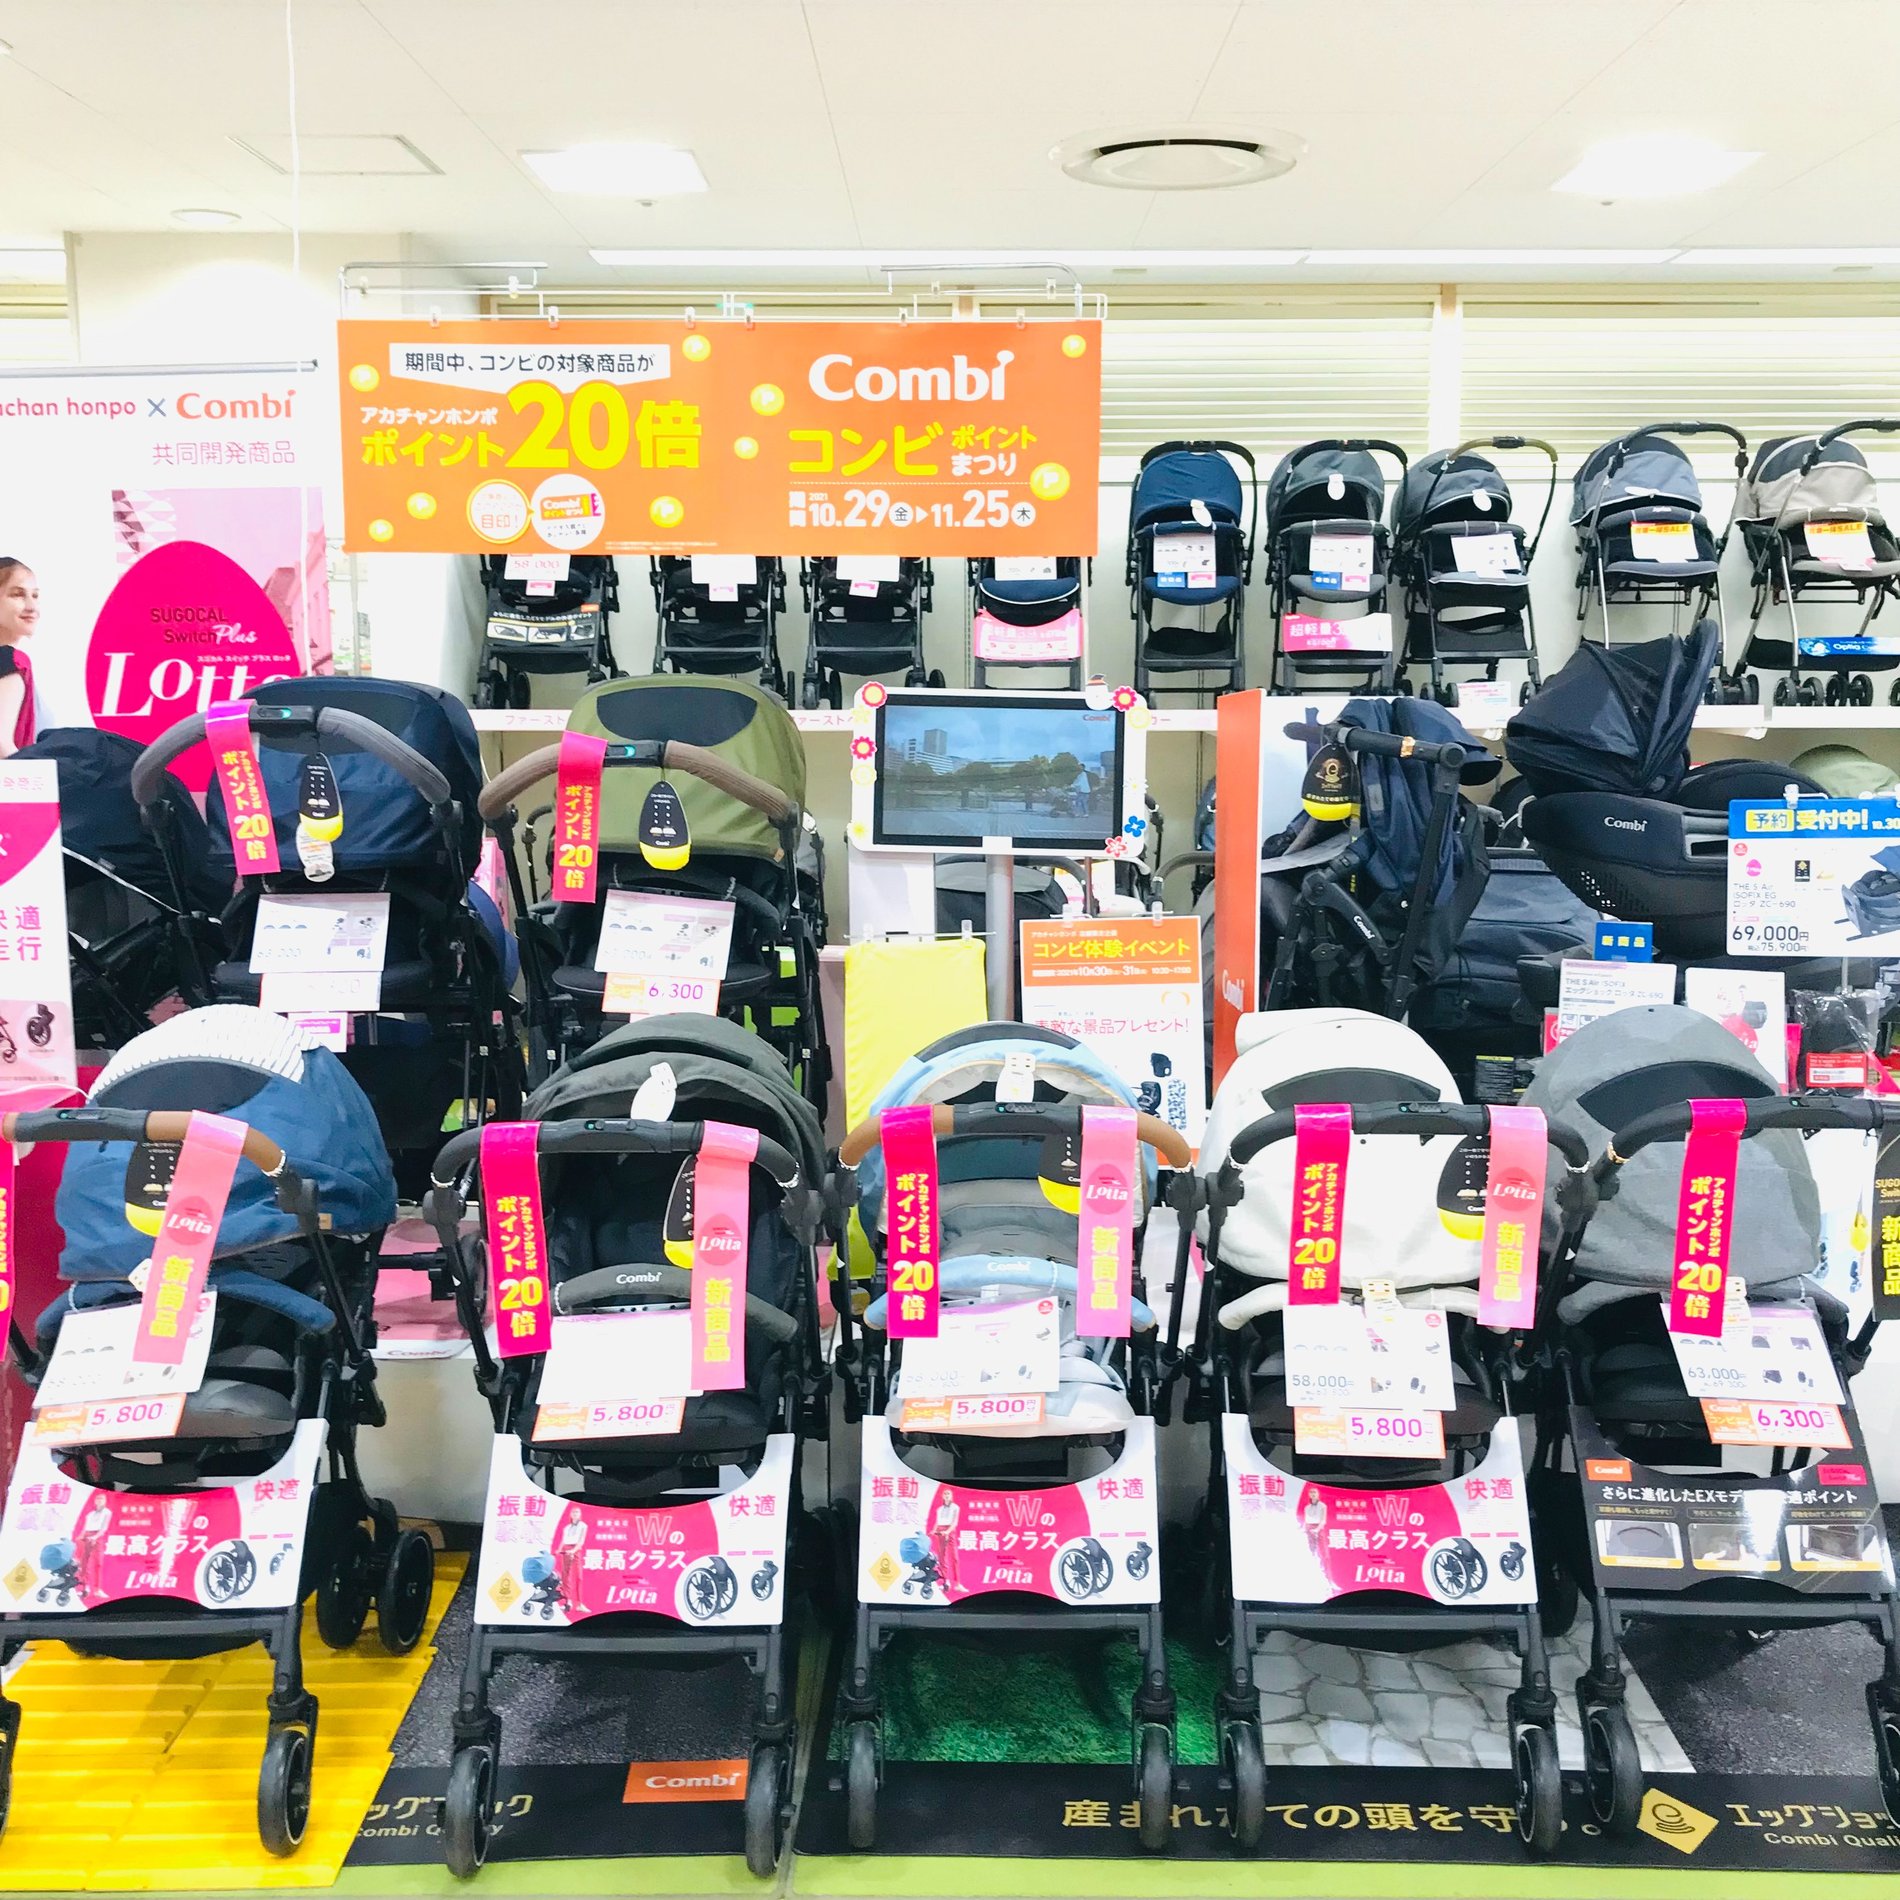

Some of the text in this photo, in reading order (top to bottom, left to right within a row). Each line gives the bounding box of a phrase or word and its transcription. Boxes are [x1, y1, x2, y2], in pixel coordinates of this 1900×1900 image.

[404, 352, 656, 373] 期間中、コンビの対象商品が
[808, 350, 1015, 401] Combi
[67, 396, 136, 419] honpo
[176, 389, 297, 420] Combi
[360, 406, 499, 426] アカチャンホンポ
[152, 440, 296, 465] 共同開発商品
[788, 421, 1038, 477] コンビ ポイント
[950, 453, 1017, 477] まつり
[151, 607, 229, 623] SUGOCAL
[93, 651, 292, 718] Lott
[1604, 816, 1648, 832] Combi
[0, 905, 42, 930] 適
[1033, 938, 1191, 959] コンビ体験イベント
[649, 983, 703, 1000] 6,300
[1086, 1184, 1128, 1201] Lotta
[1493, 1183, 1537, 1201] Lotta
[166, 1214, 213, 1235] Lotta
[699, 1235, 742, 1252] Lotta
[615, 1271, 662, 1285] Combi
[92, 1402, 163, 1426] 5,800
[592, 1405, 664, 1423] 5,800
[957, 1400, 1025, 1414] 5,800
[1351, 1417, 1423, 1438] 5,800
[1757, 1408, 1825, 1429] 6,300
[20, 1483, 72, 1505] 振動
[254, 1479, 301, 1502] 快適
[872, 1476, 919, 1499] 振動
[1096, 1477, 1145, 1500] 快適
[1238, 1474, 1285, 1497] 振動
[1463, 1477, 1514, 1501] 快適
[497, 1494, 547, 1518] 振動
[729, 1494, 776, 1517] 快適
[957, 1529, 1061, 1552] 最高クラス
[1327, 1529, 1431, 1550] 最高クラス
[583, 1548, 688, 1571] 最高クラス
[981, 1565, 1033, 1585] Lotta
[1354, 1564, 1406, 1584] Lotta
[605, 1585, 658, 1605] Lotta
[645, 1772, 741, 1789] Combi
[1764, 1832, 1837, 1846] Combi
